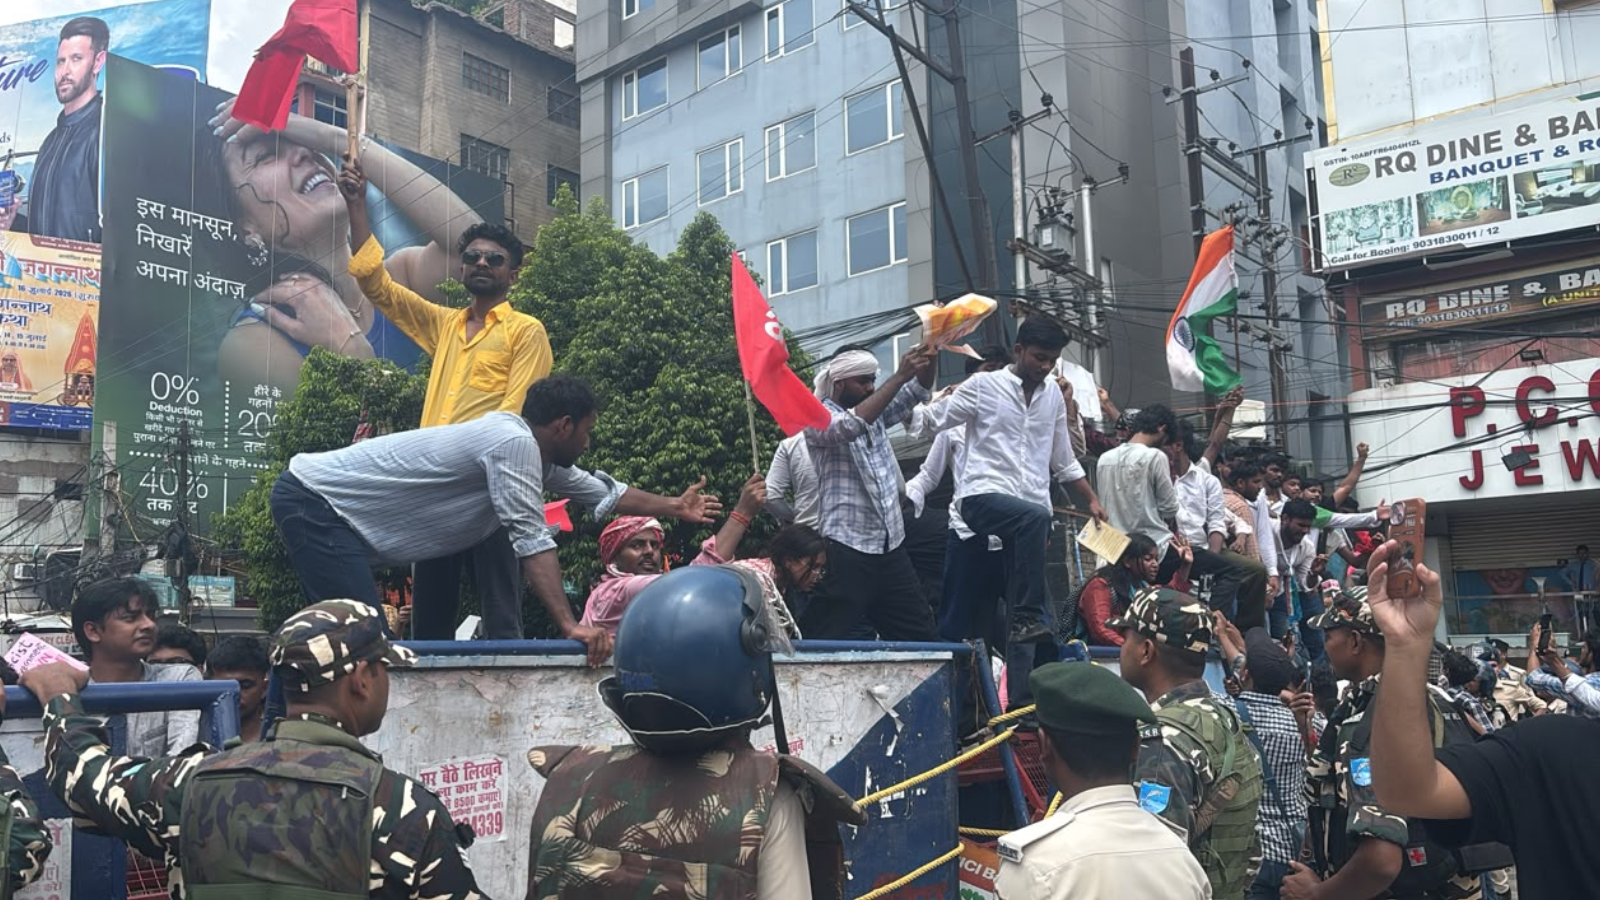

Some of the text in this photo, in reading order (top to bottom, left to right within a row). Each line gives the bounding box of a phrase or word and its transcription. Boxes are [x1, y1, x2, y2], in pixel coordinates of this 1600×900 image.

[1375, 106, 1600, 179] RQ DINE & BA
[1430, 149, 1544, 184] BANQUET
[1552, 144, 1571, 159] &
[136, 197, 238, 242] इस मानसून,
[136, 223, 192, 258] निखारें
[1331, 254, 1351, 264] Call
[1353, 250, 1368, 261] for
[1413, 231, 1478, 250] 9031830011
[1486, 226, 1500, 236] 12
[136, 260, 247, 300] अपना अंदाज़
[1386, 298, 1427, 319] RQ
[1438, 284, 1511, 311] DINE
[1522, 281, 1547, 297] &
[149, 400, 203, 418] Deduction
[253, 384, 270, 397] हीरे
[462, 757, 503, 782] लिखने
